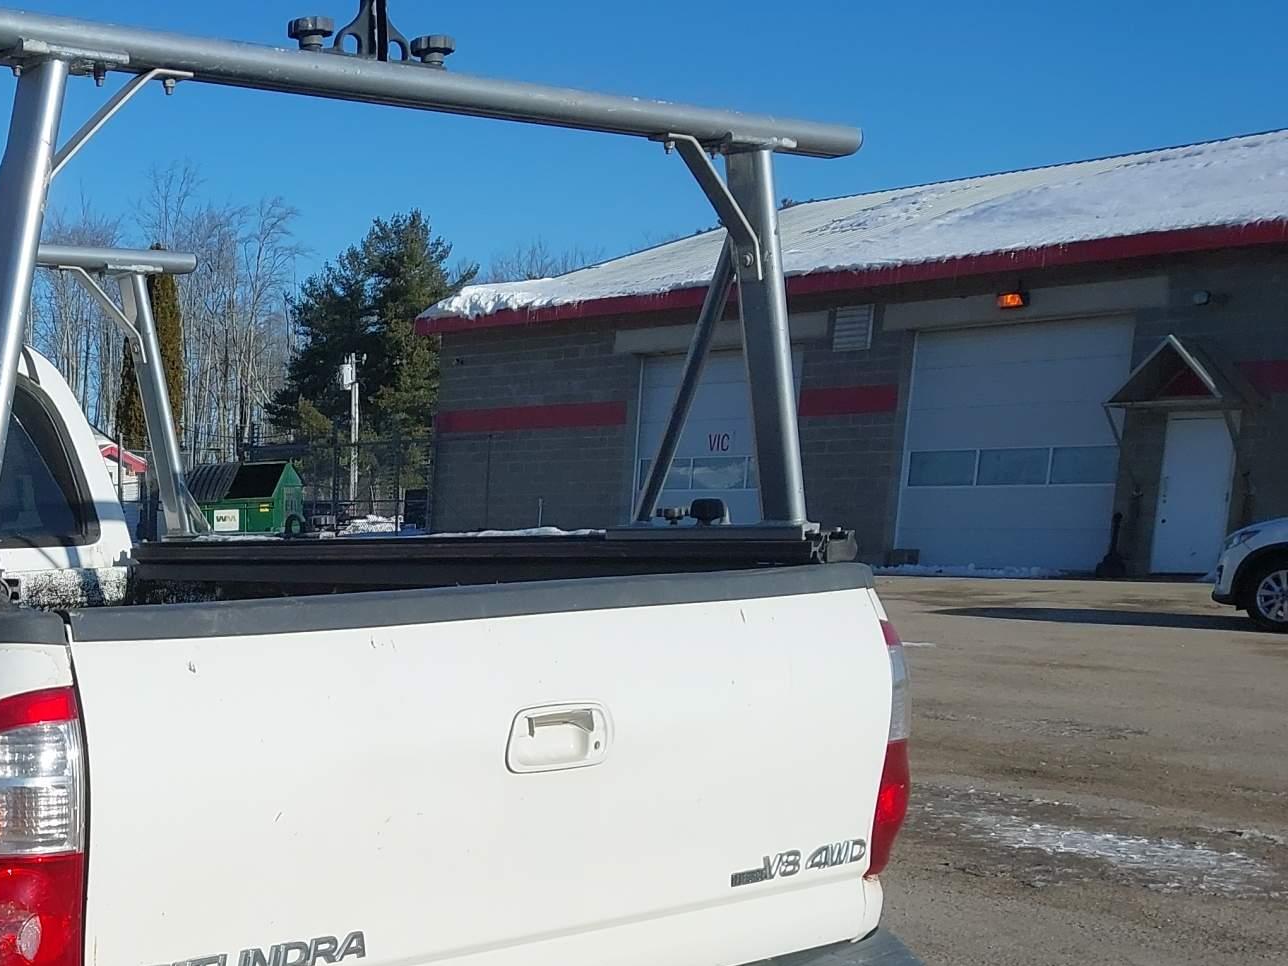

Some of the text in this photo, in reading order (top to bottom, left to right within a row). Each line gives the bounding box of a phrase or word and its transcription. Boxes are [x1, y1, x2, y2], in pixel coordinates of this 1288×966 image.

[708, 433, 730, 451] VIC
[762, 849, 801, 878] V8
[805, 838, 867, 870] 4WD
